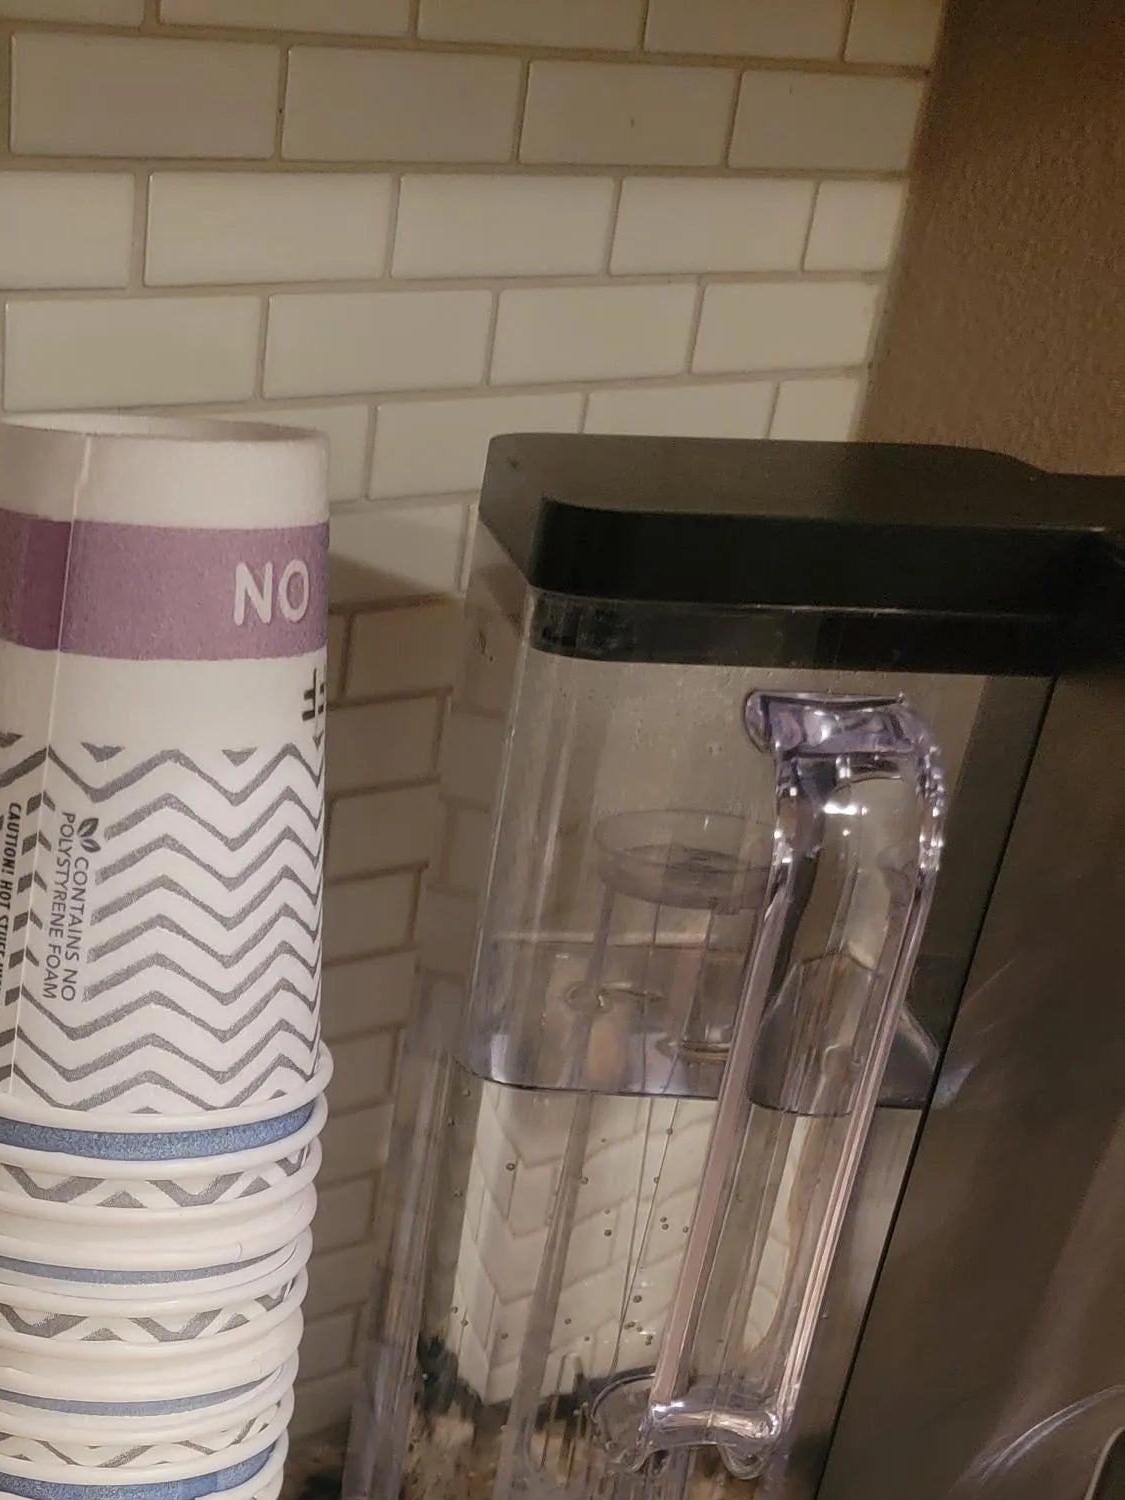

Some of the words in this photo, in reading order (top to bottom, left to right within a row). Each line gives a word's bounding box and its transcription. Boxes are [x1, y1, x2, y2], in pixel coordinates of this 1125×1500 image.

[1, 802, 22, 876] CAUTION!
[49, 811, 76, 938] POLYSTYRENE
[65, 856, 89, 961] CONTAINS
[43, 943, 62, 999] FOAM
[61, 968, 78, 1001] NO
